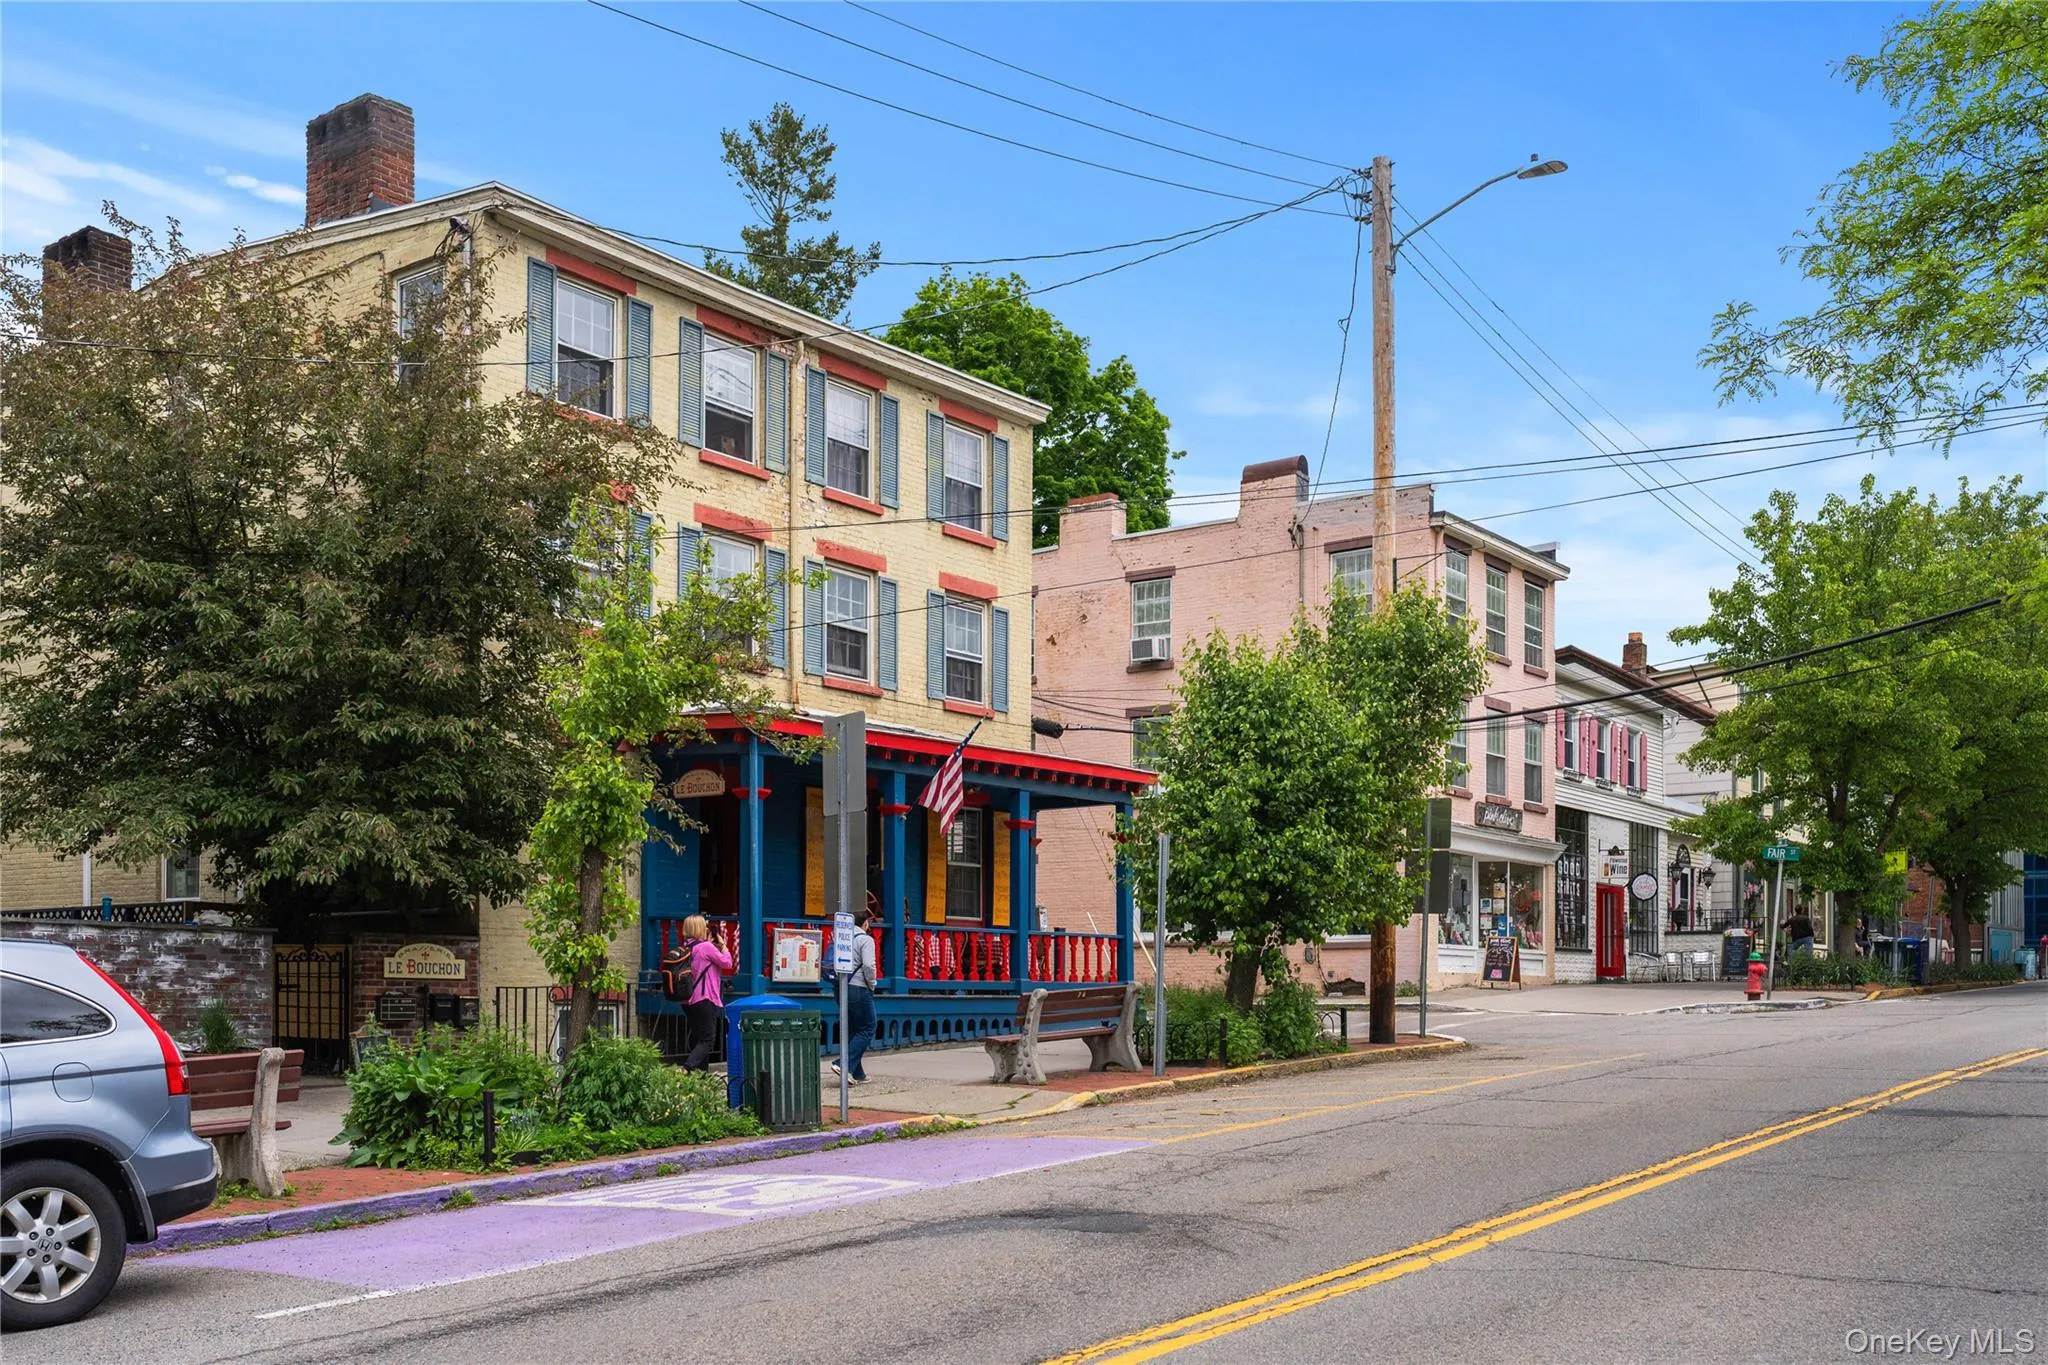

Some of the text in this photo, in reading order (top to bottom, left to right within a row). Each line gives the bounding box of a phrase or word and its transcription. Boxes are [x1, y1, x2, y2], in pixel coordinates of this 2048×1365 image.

[676, 784, 685, 794] LE
[1767, 848, 1786, 858] FAIR
[1610, 864, 1628, 876] Wine
[388, 958, 460, 975] LE BOUCHON
